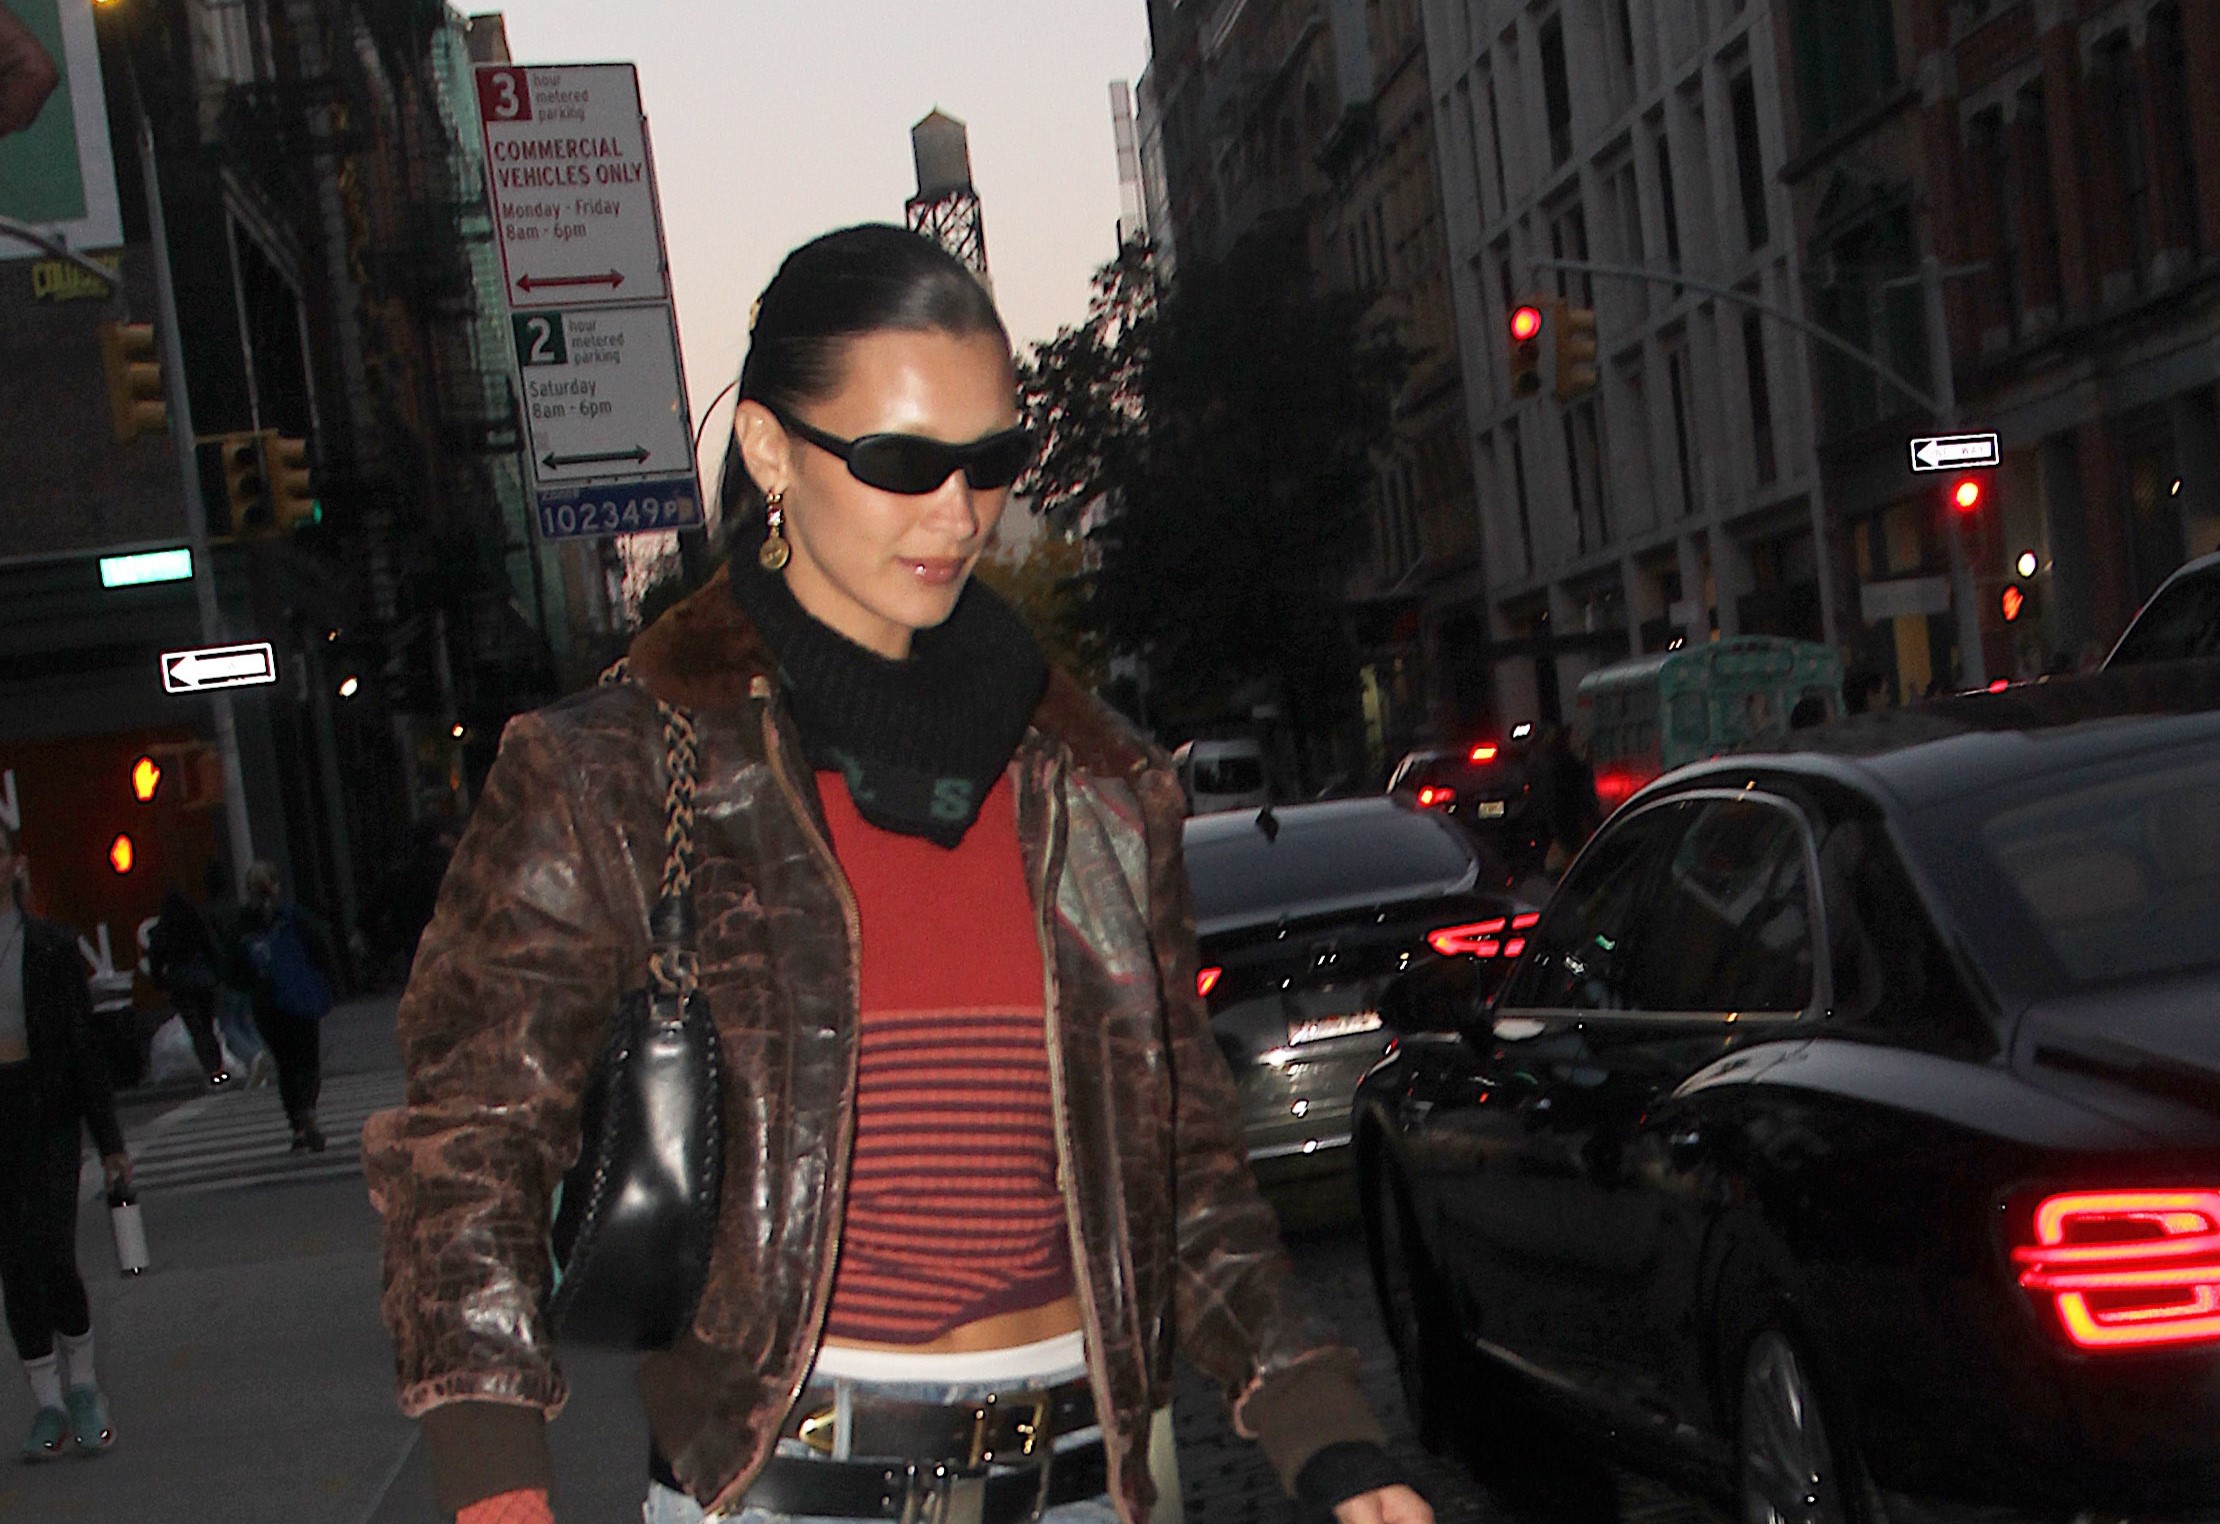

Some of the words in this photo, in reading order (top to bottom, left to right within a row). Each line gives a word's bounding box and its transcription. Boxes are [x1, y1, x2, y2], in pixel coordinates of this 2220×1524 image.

[533, 74, 561, 87] hour
[491, 72, 519, 117] 3
[536, 89, 589, 103] metered
[538, 106, 586, 124] parking
[494, 137, 623, 162] COMMERCIAL
[499, 165, 591, 188] VEHICLES
[596, 163, 642, 185] ONLY
[502, 202, 561, 220] Monday
[576, 200, 620, 217] Friday
[506, 225, 539, 240] 8am
[554, 223, 587, 241] 6pm
[568, 319, 597, 332] hour
[526, 317, 555, 362] 2
[572, 332, 625, 348] metered
[574, 350, 621, 365] parking
[529, 378, 596, 398] Saturday
[532, 402, 566, 419] 8am
[579, 400, 612, 418] 6pm
